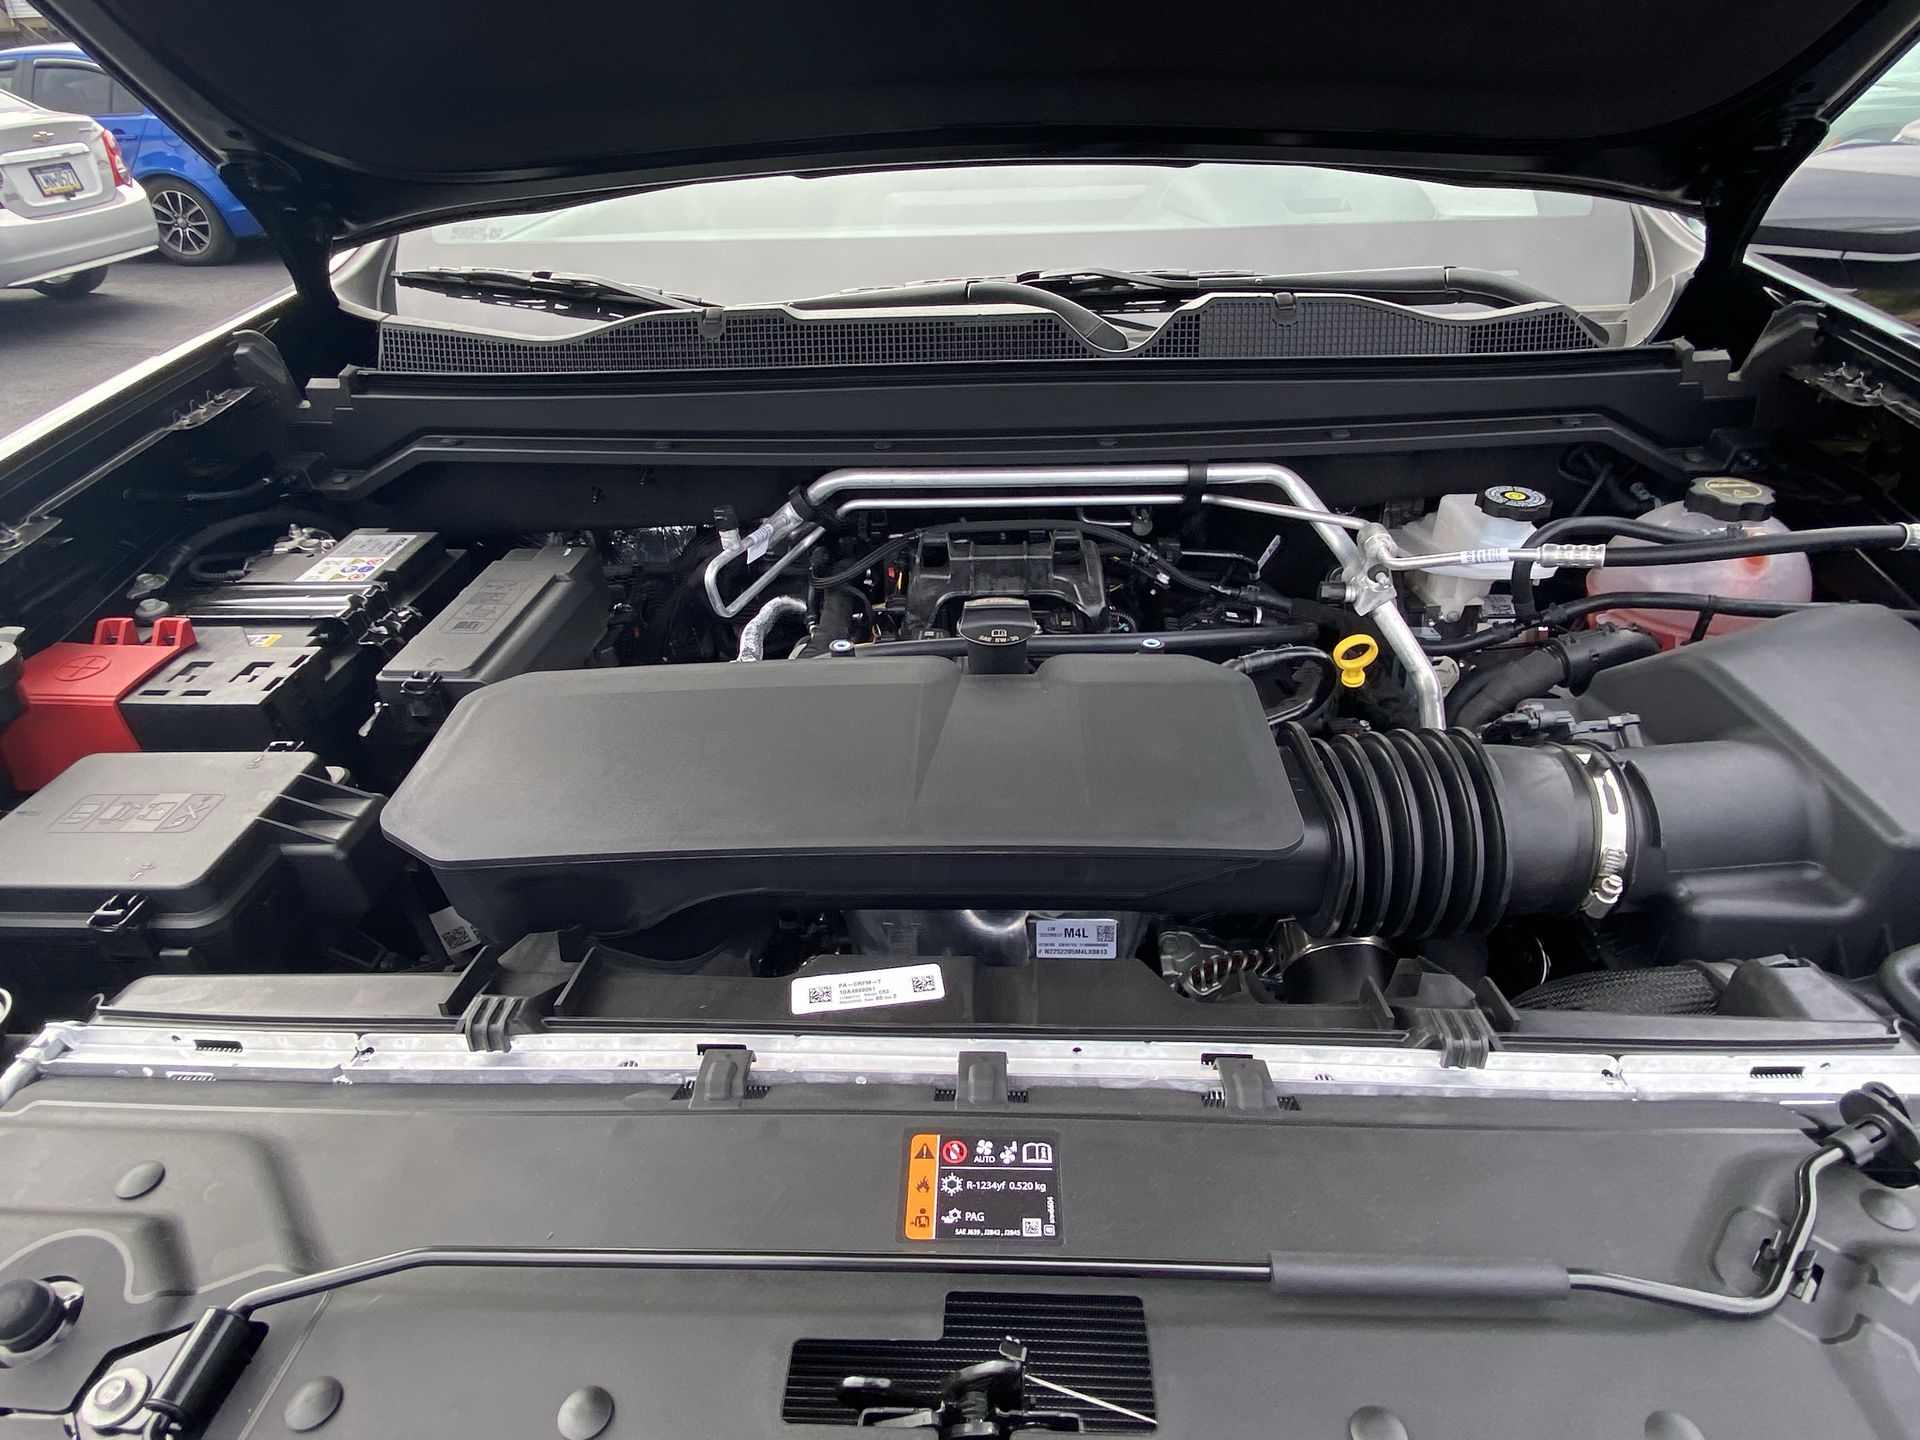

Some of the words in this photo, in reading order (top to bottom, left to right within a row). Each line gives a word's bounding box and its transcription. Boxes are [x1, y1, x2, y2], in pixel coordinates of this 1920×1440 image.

[1064, 927, 1089, 938] M4L
[974, 1155, 996, 1164] AUTO
[966, 1181, 1006, 1191] R-1234yf
[1009, 1181, 1033, 1191] 0.520
[1034, 1181, 1047, 1193] kg
[965, 1211, 985, 1222] PAG
[955, 1228, 966, 1236] SAE
